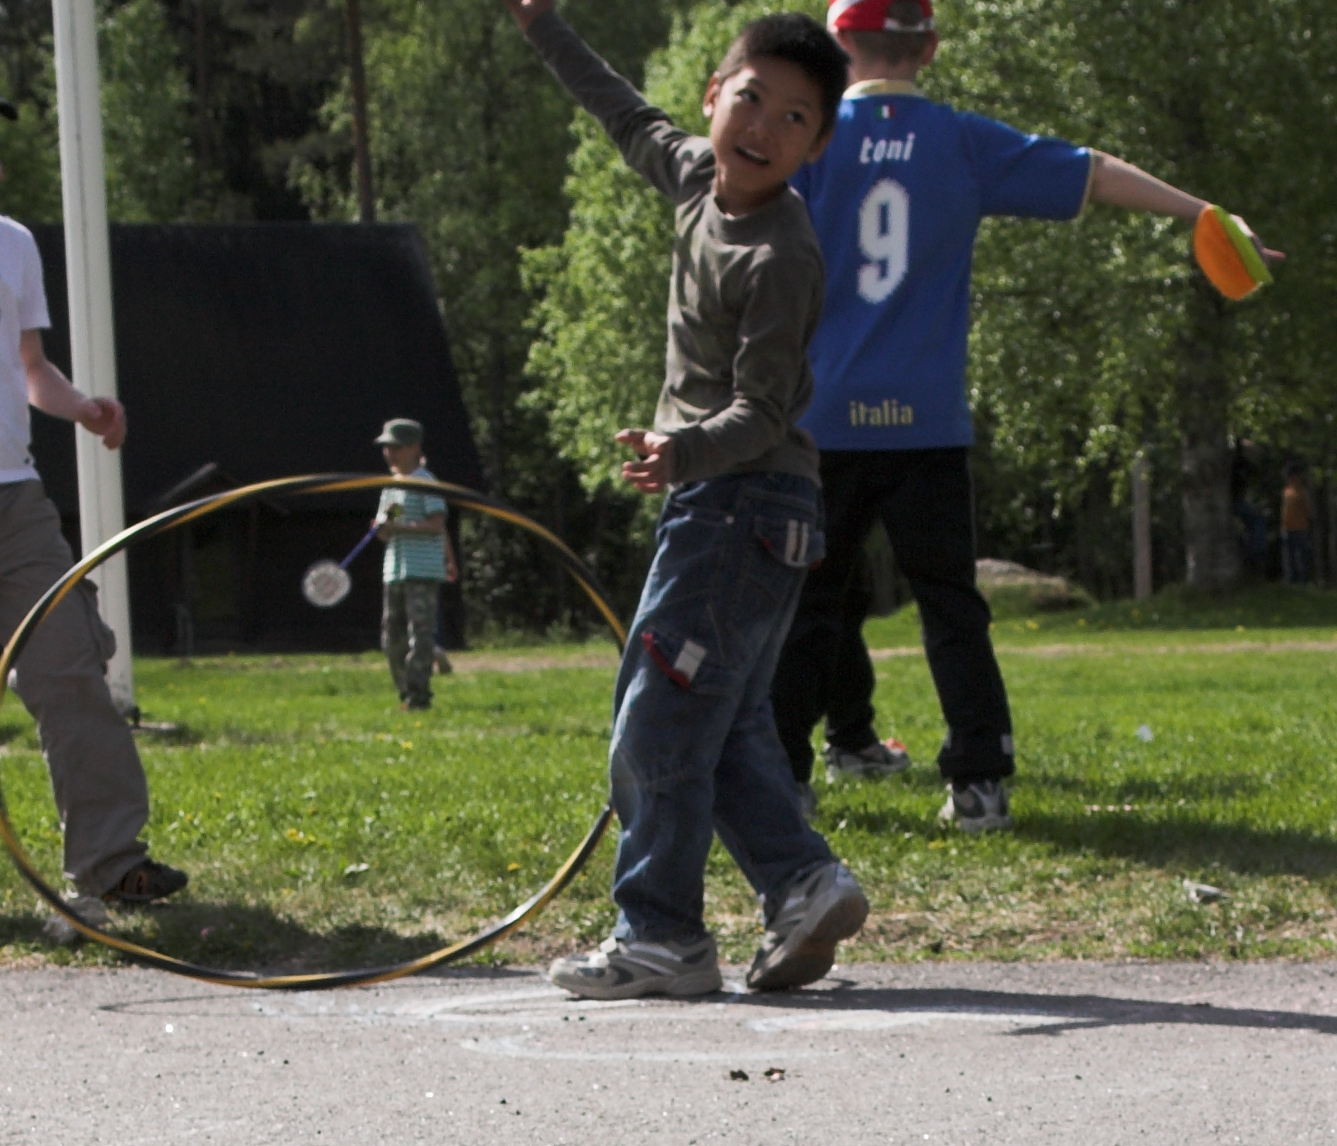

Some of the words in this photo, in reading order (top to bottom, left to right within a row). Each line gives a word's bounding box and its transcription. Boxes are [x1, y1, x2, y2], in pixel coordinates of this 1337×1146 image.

[859, 132, 915, 163] toni
[857, 178, 910, 303] 9
[849, 400, 914, 426] italia
